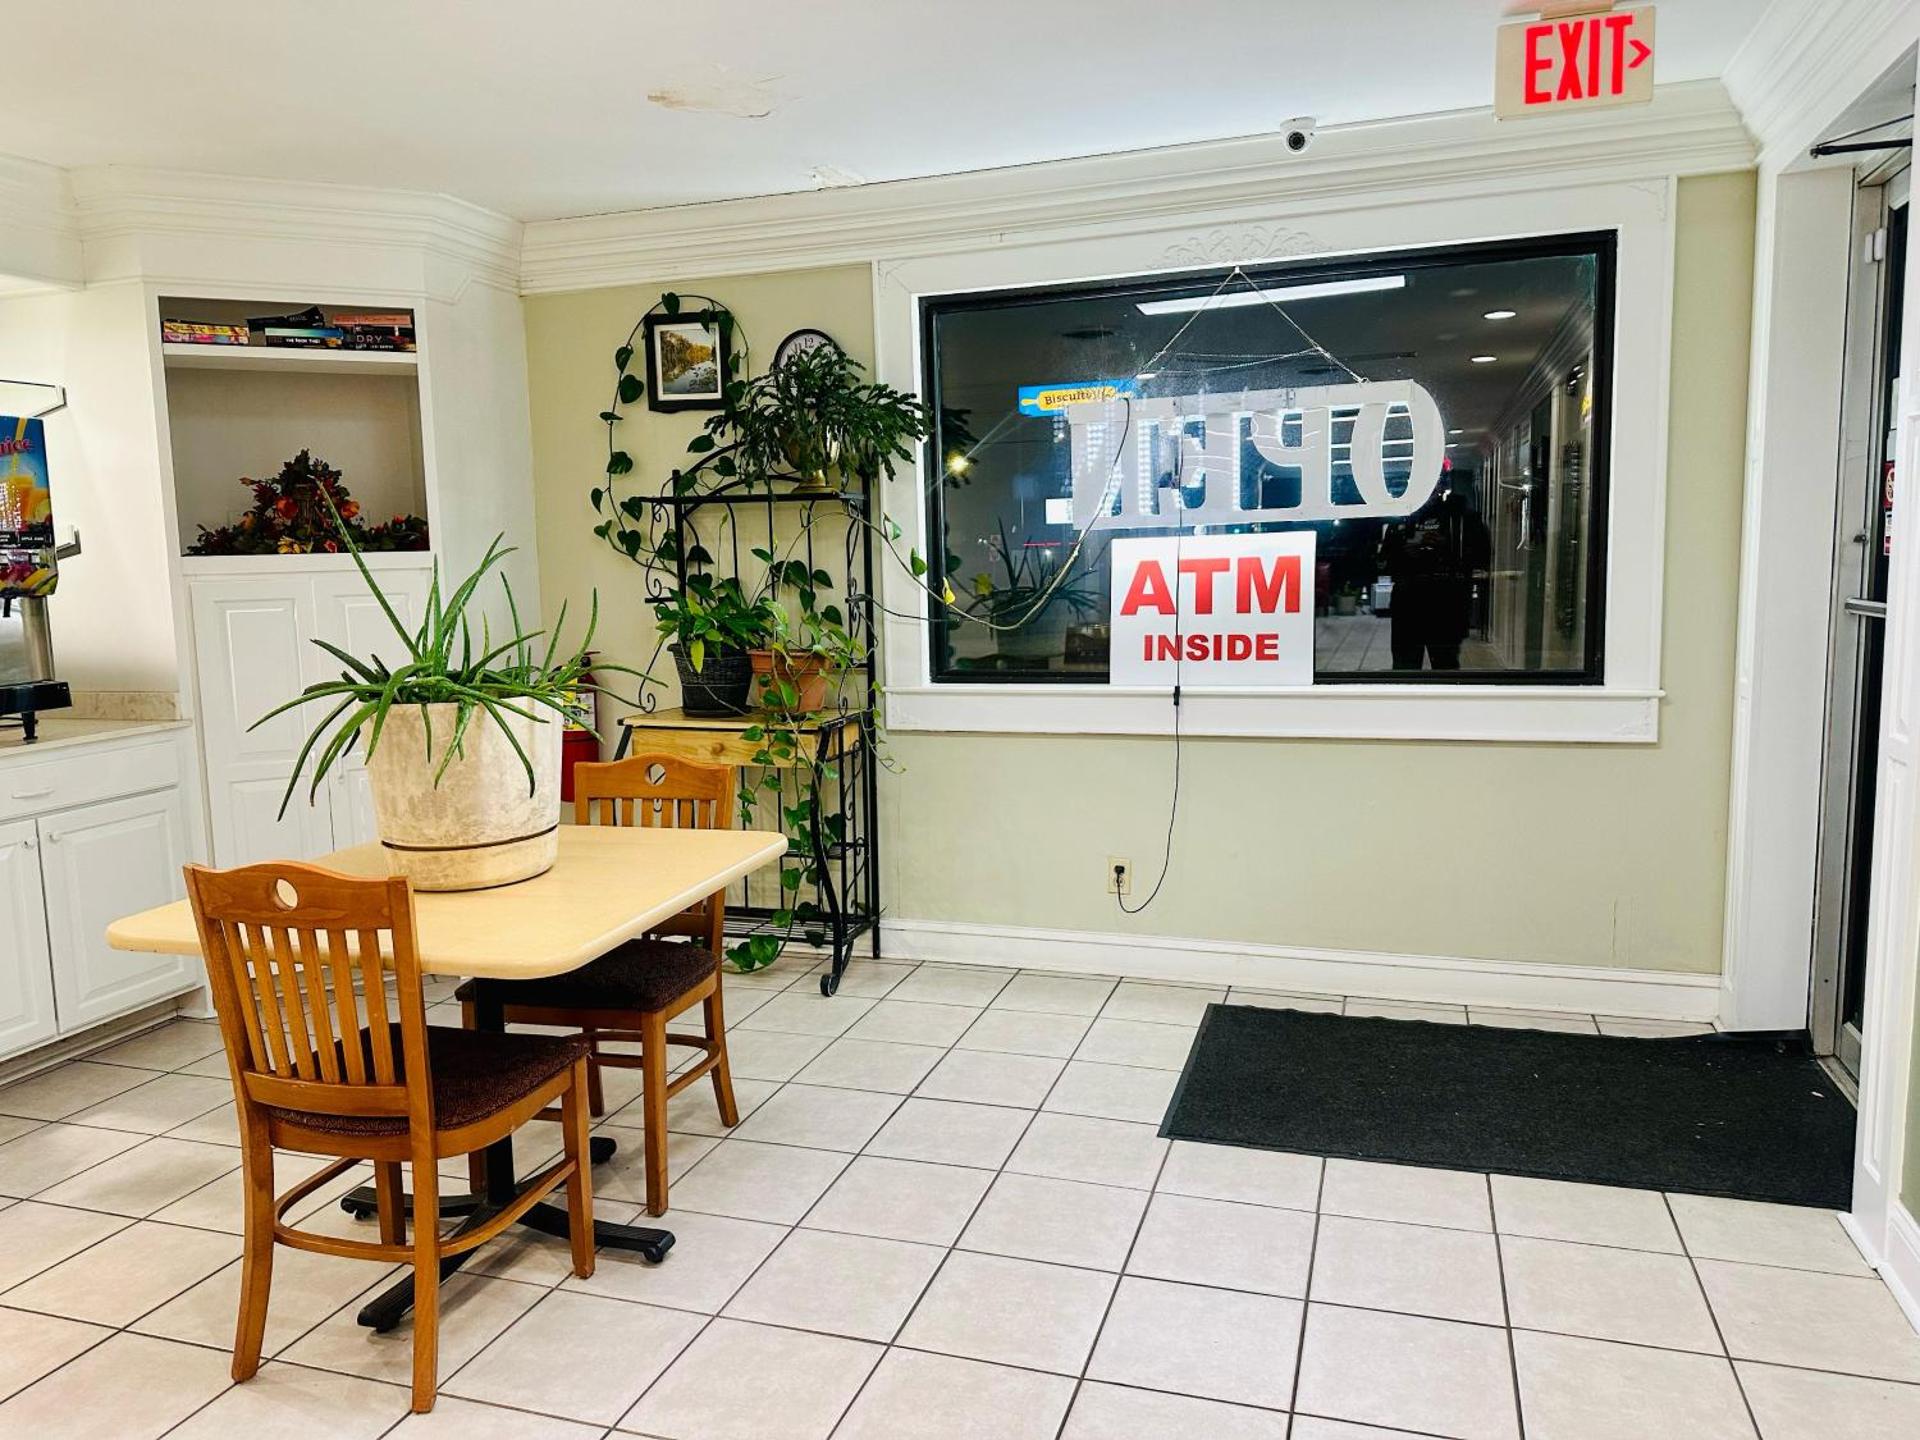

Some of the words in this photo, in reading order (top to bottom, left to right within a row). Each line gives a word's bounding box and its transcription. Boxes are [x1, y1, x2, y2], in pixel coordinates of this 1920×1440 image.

[1525, 14, 1633, 104] EXIT
[356, 334, 382, 343] DRY
[1120, 556, 1301, 615] ATM
[1144, 633, 1280, 661] INSIDE
